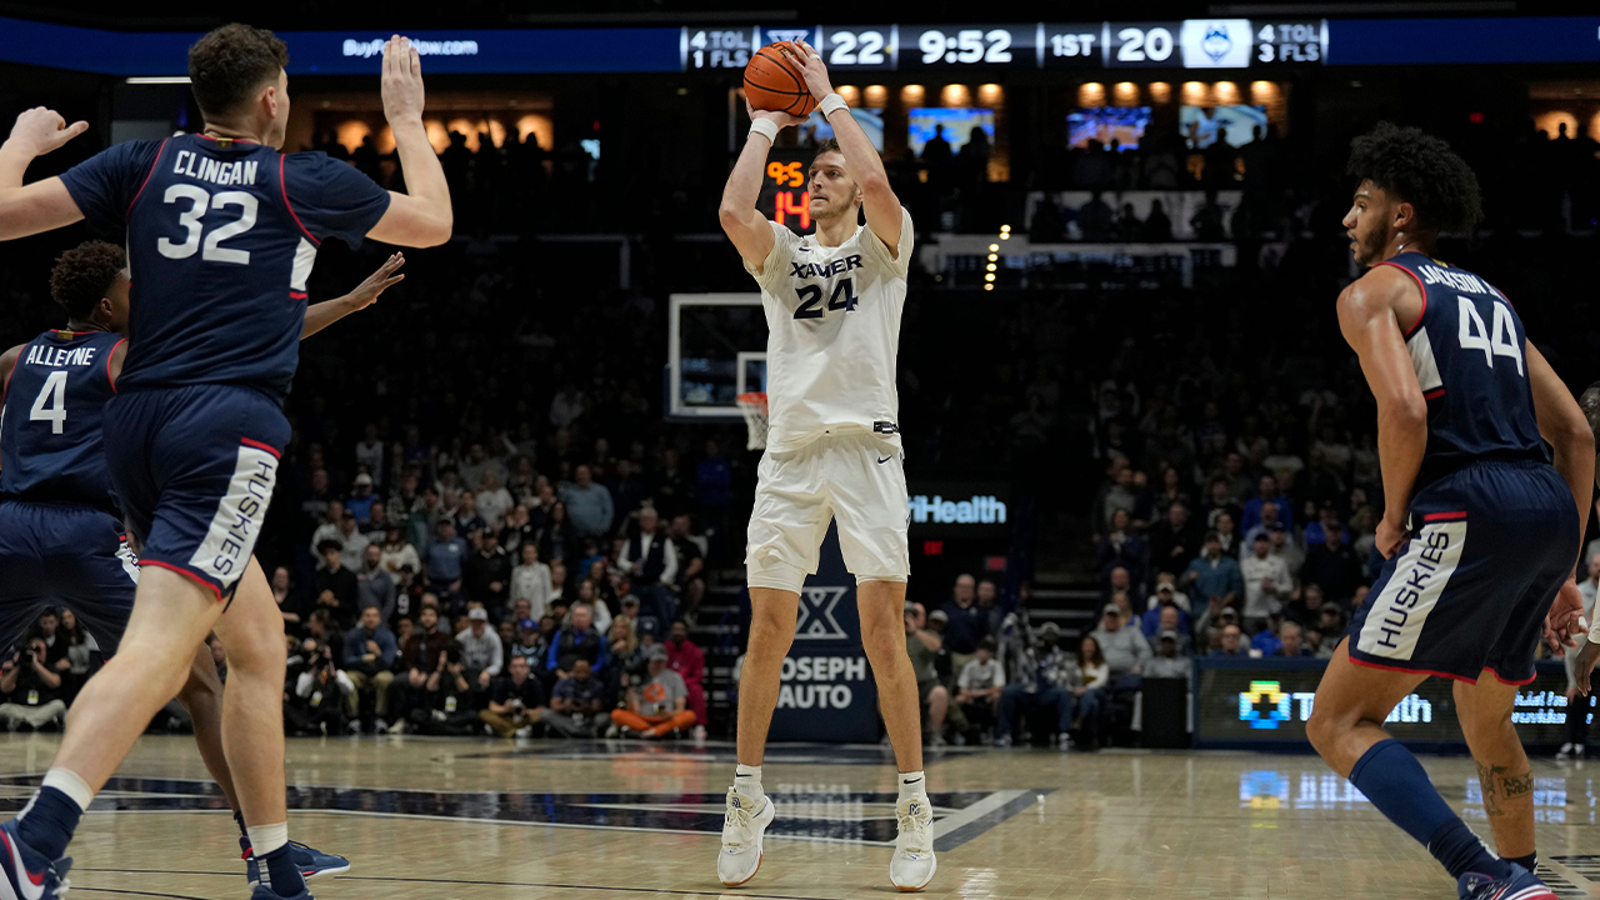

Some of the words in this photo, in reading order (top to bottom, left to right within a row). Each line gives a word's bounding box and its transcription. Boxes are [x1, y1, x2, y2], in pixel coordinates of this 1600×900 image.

[690, 30, 708, 49] 4
[709, 30, 750, 49] TOL
[829, 30, 885, 65] 22
[918, 28, 1013, 64] 9:52
[1050, 33, 1096, 57] 1ST
[1116, 27, 1174, 62] 20
[1257, 24, 1275, 43] 4
[1277, 24, 1320, 43] TOL
[692, 49, 704, 68] 1
[710, 49, 749, 68] FLS
[1258, 43, 1275, 62] 3
[1279, 43, 1320, 62] FLS
[173, 150, 258, 186] CLINGAN
[767, 161, 804, 188] 9:5
[157, 183, 259, 265] 32
[774, 190, 811, 229] 14
[1417, 264, 1487, 294] JACKSON
[793, 277, 859, 320] 24
[1456, 295, 1525, 378] 44
[25, 345, 96, 367] ALLEYNE
[29, 370, 69, 435] 4
[213, 460, 273, 576] HUSKIES
[1377, 531, 1450, 649] HUSKIES
[780, 656, 866, 681] OSEPH
[776, 684, 853, 709] AUTO
